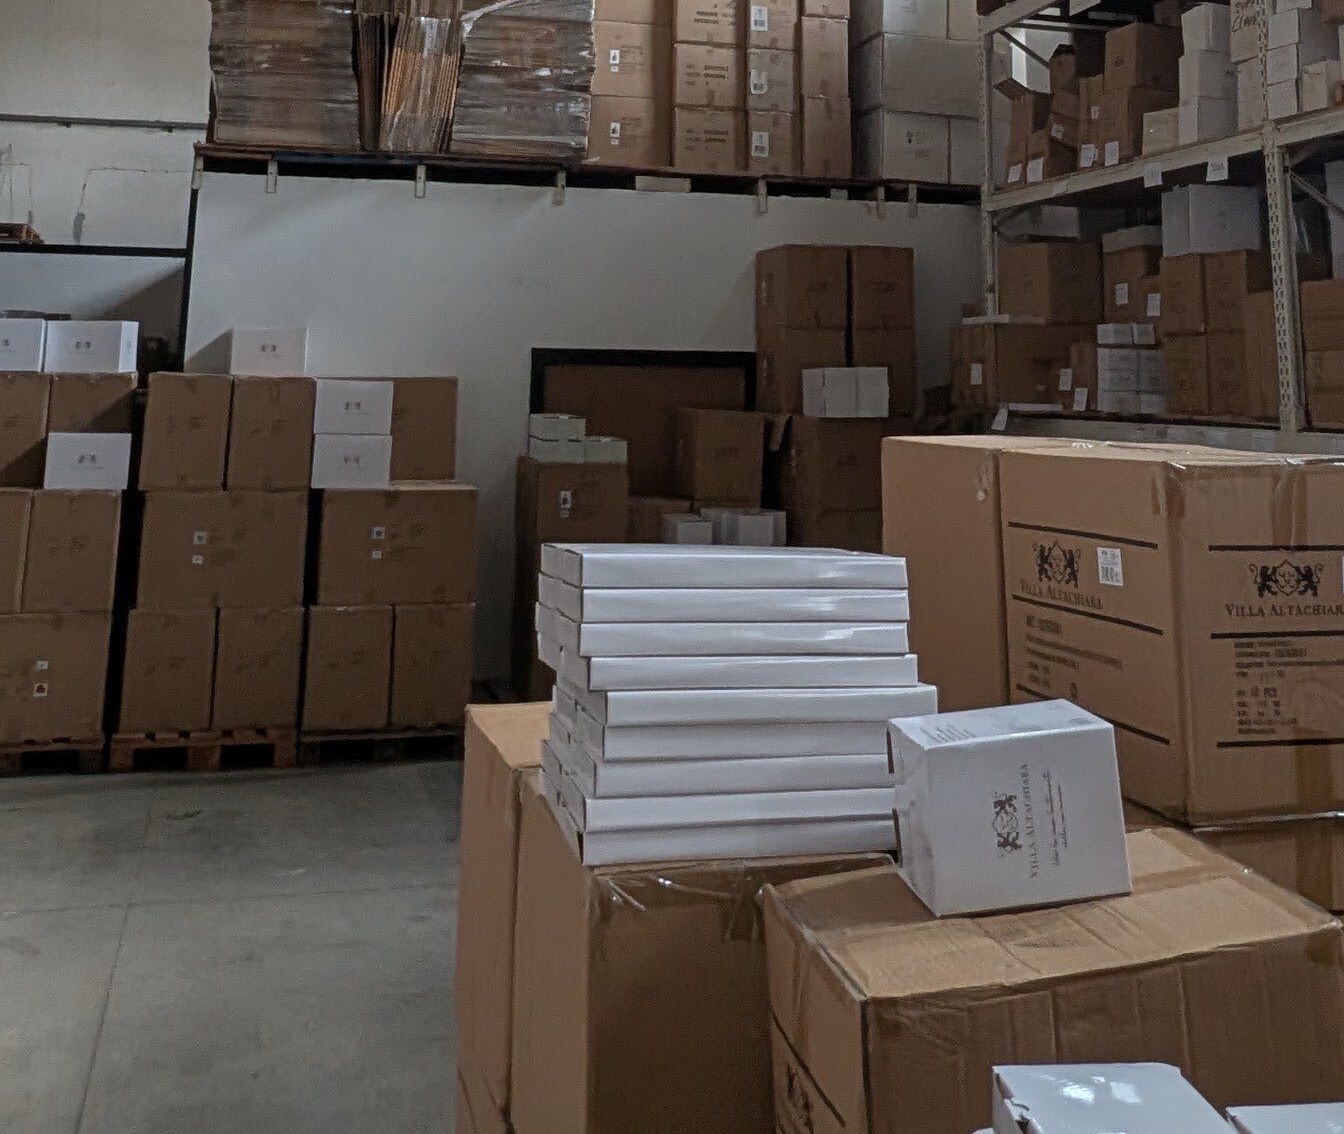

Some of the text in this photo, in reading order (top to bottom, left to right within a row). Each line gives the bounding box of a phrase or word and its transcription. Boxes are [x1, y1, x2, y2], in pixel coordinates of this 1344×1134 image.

[1019, 578, 1103, 610] VILLA ALTACHIARA
[1224, 603, 1266, 617] VILLA
